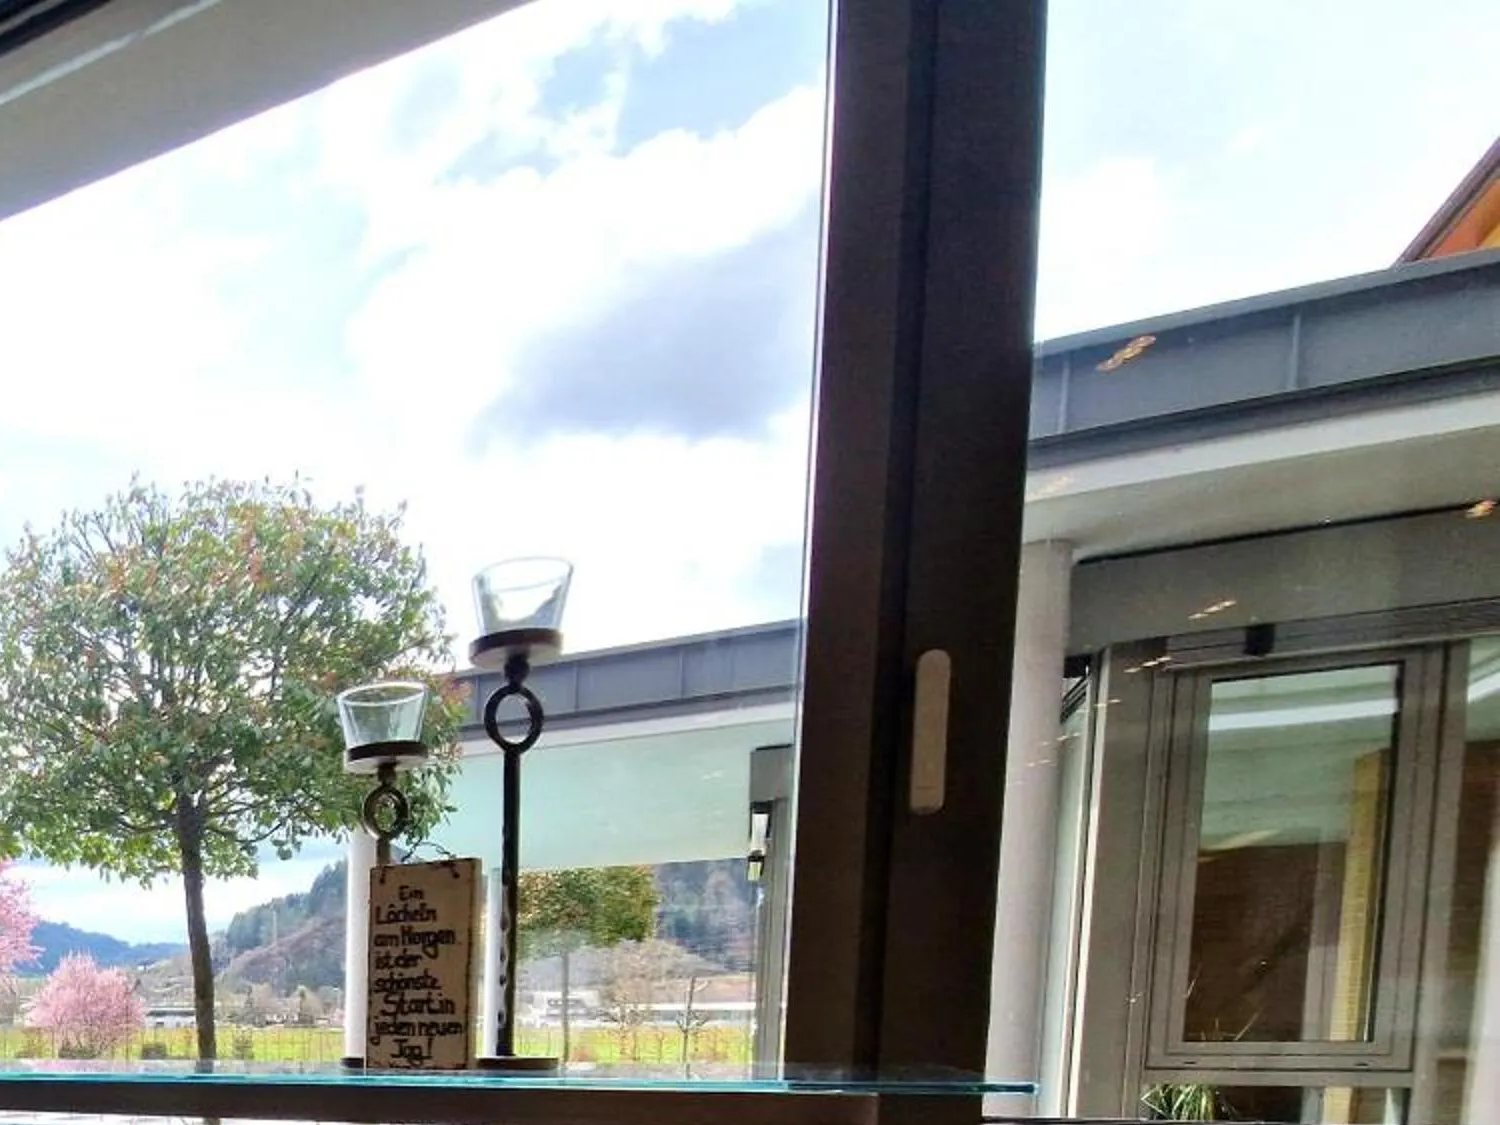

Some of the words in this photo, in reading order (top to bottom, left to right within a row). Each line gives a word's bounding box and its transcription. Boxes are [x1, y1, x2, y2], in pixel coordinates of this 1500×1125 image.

[398, 885, 424, 901] Ein
[375, 903, 437, 924] Lächeln
[374, 933, 399, 947] am
[401, 926, 455, 959] Morgen
[375, 952, 393, 970] ist
[395, 949, 422, 968] der
[373, 969, 441, 993] schönste
[381, 993, 434, 1017] Start
[436, 993, 455, 1014] in
[370, 1014, 416, 1046] jeden
[418, 1021, 463, 1036] neuen
